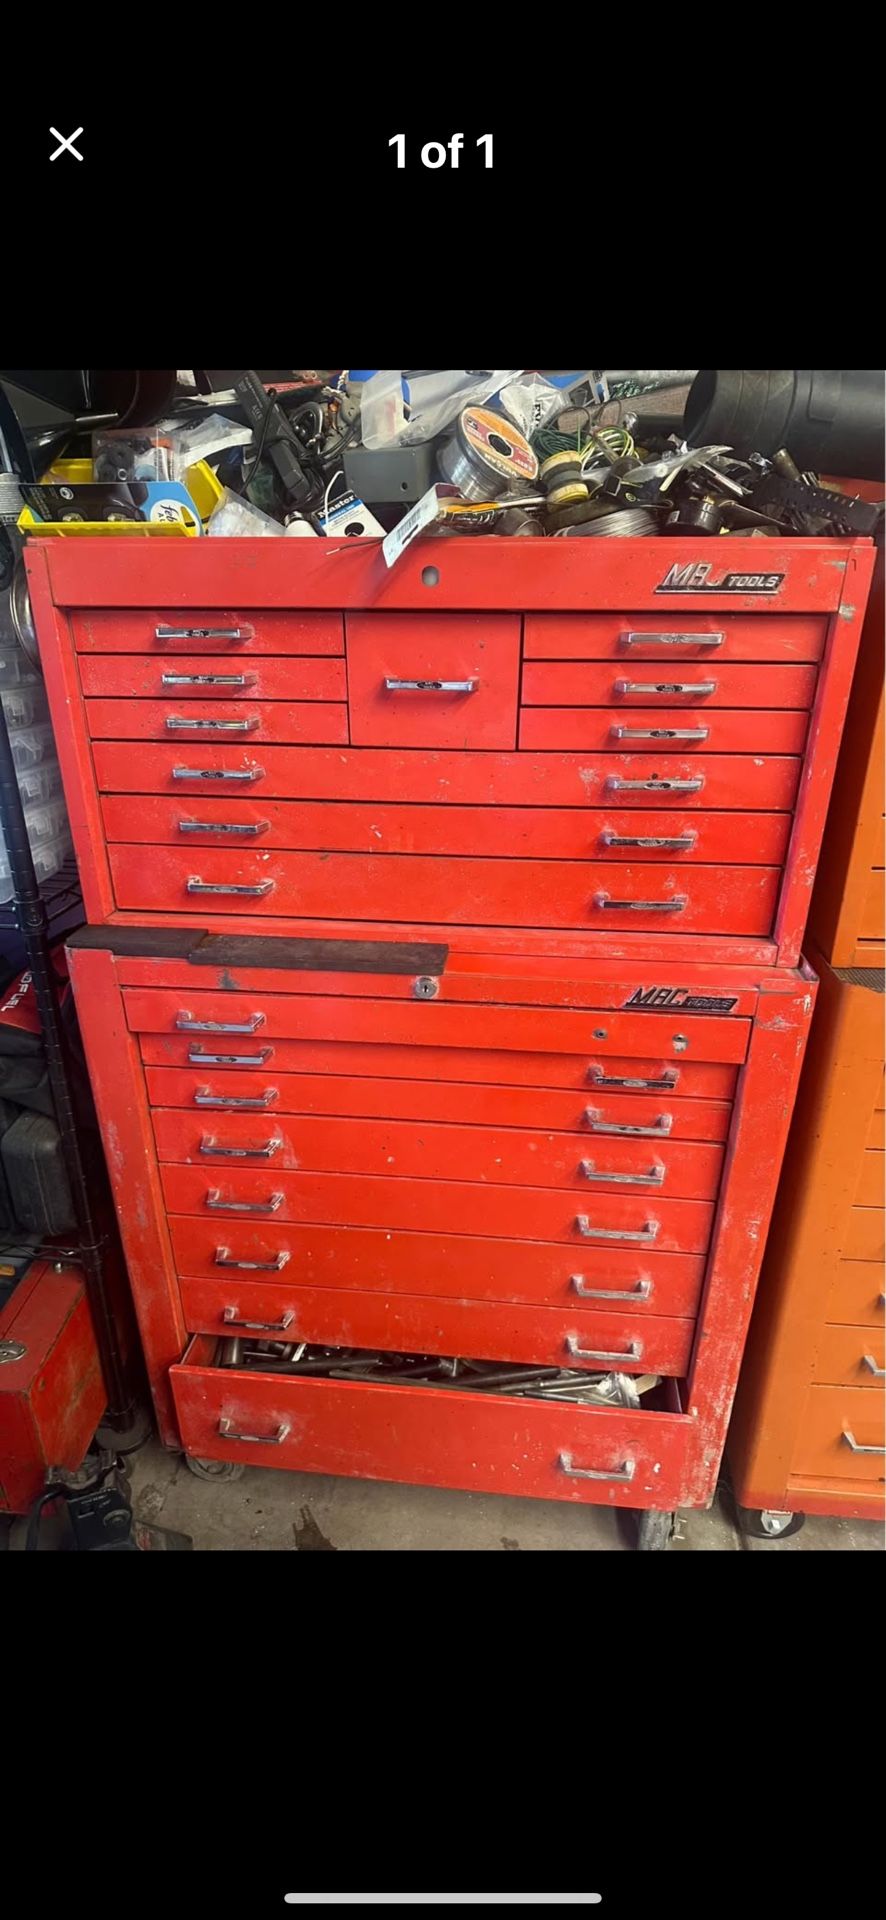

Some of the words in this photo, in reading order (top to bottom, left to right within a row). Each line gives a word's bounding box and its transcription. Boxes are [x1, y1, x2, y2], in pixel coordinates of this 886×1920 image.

[317, 494, 355, 519] Master
[727, 575, 779, 588] TOOLS
[628, 986, 689, 1007] MAC
